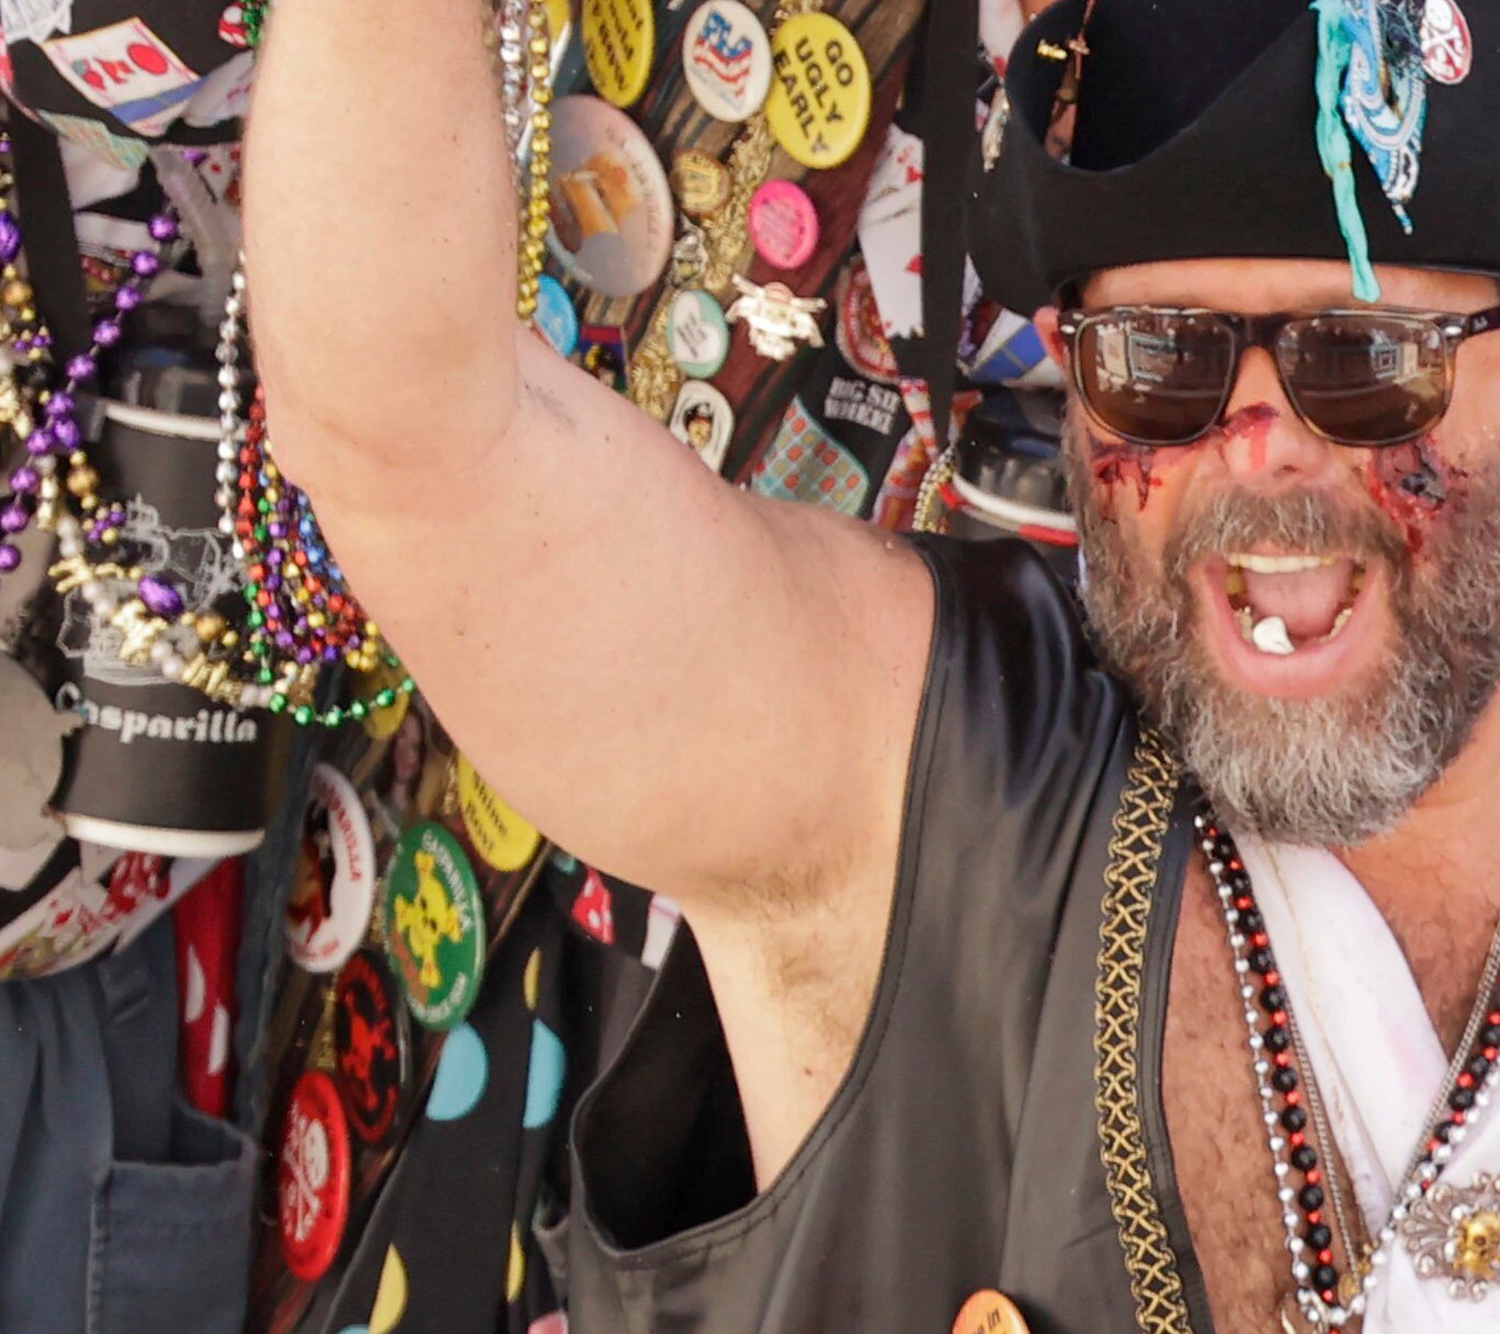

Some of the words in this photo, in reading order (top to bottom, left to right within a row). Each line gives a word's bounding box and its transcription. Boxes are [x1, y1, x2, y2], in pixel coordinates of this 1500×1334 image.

[773, 48, 831, 155] EARLY
[794, 36, 843, 124] UGLY
[824, 39, 854, 88] GO
